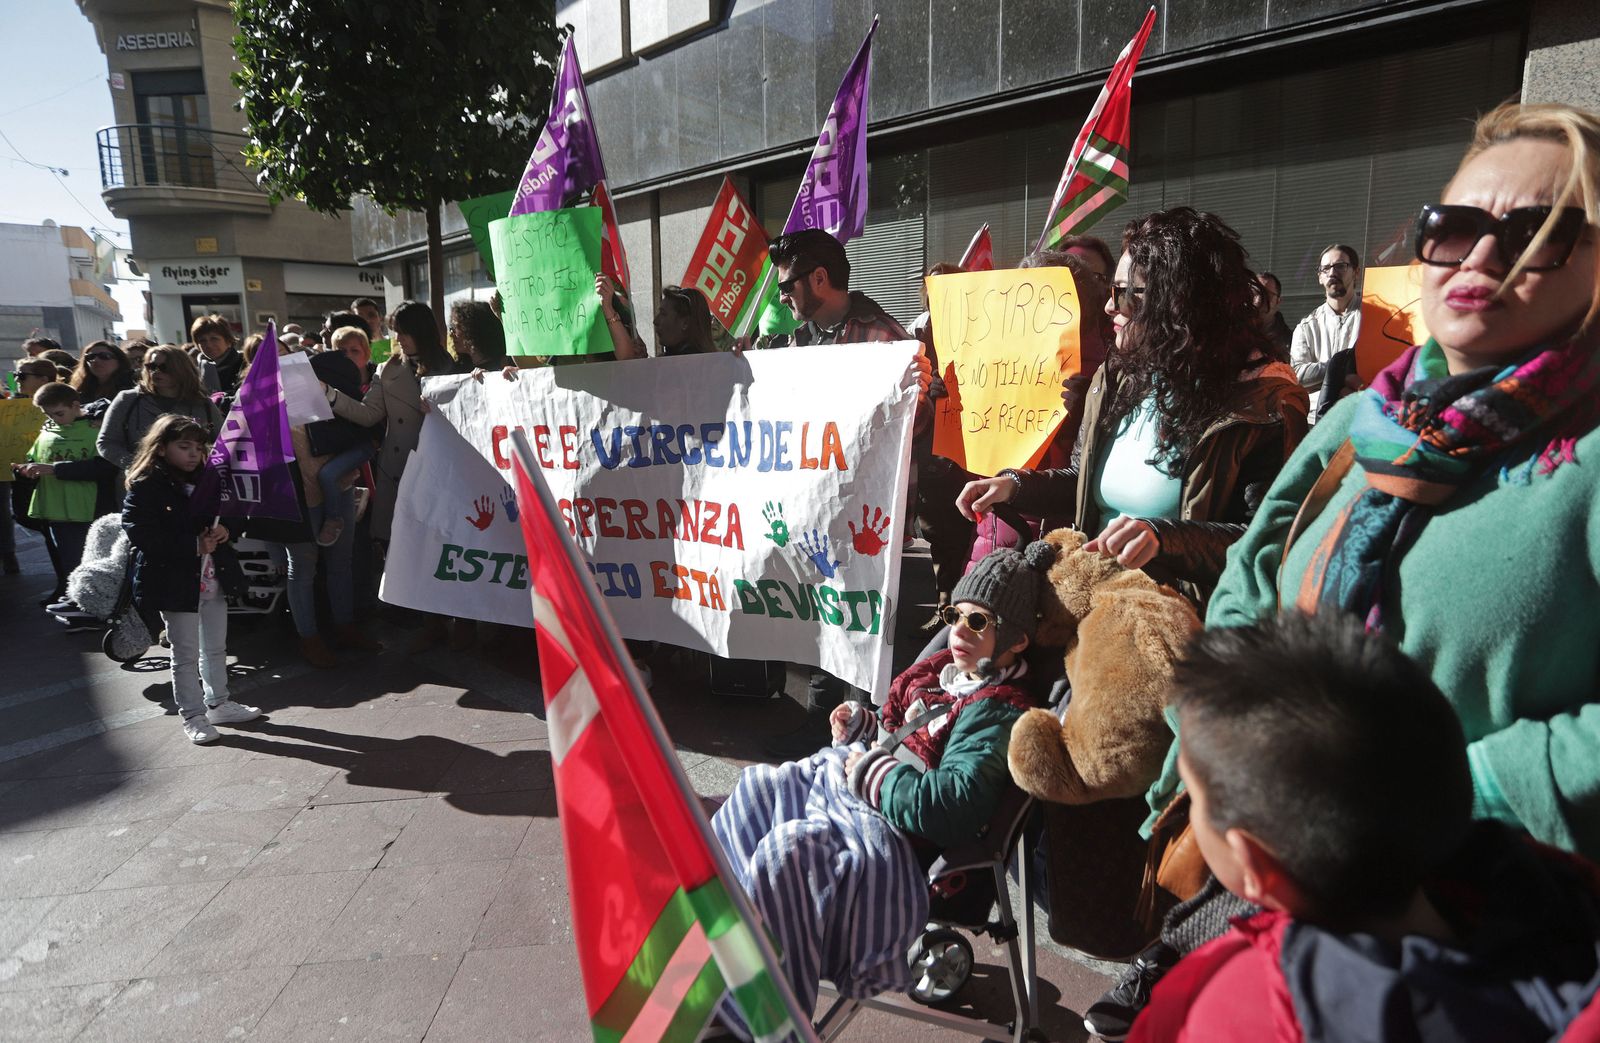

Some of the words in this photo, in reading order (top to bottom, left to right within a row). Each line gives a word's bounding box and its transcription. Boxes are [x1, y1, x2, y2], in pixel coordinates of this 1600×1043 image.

[117, 32, 195, 50] ASESORIA
[161, 265, 197, 280] flying
[199, 265, 230, 279] tiger
[757, 420, 793, 472] DE
[800, 421, 849, 471] LA
[557, 497, 745, 551] SPERANZA
[433, 544, 529, 590] ESTE
